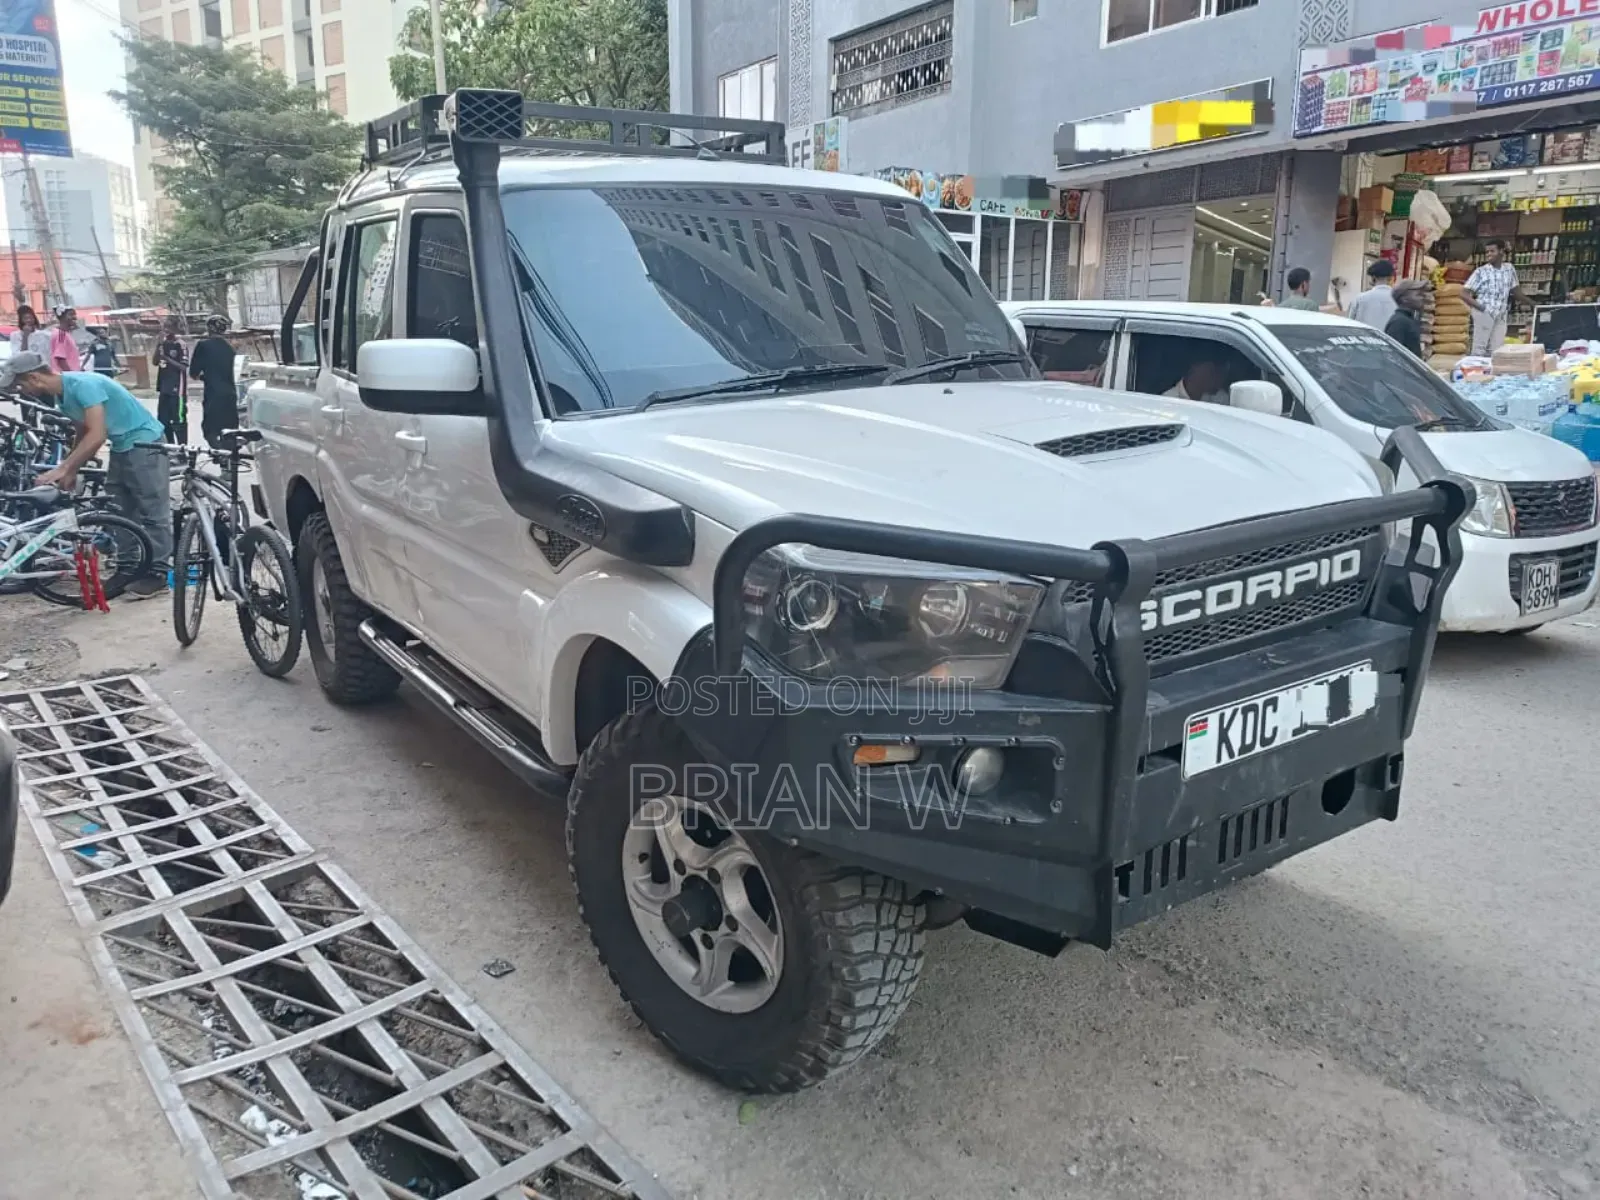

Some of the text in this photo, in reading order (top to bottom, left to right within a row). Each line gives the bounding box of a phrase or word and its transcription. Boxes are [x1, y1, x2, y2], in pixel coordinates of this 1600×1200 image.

[5, 38, 47, 53] HOSPITAL
[5, 51, 46, 64] MATERNITY
[1504, 84, 1536, 98] 0117
[1539, 79, 1564, 92] 287
[1568, 74, 1593, 88] 567
[1528, 566, 1552, 589] KDH
[1216, 694, 1279, 765] KDC
